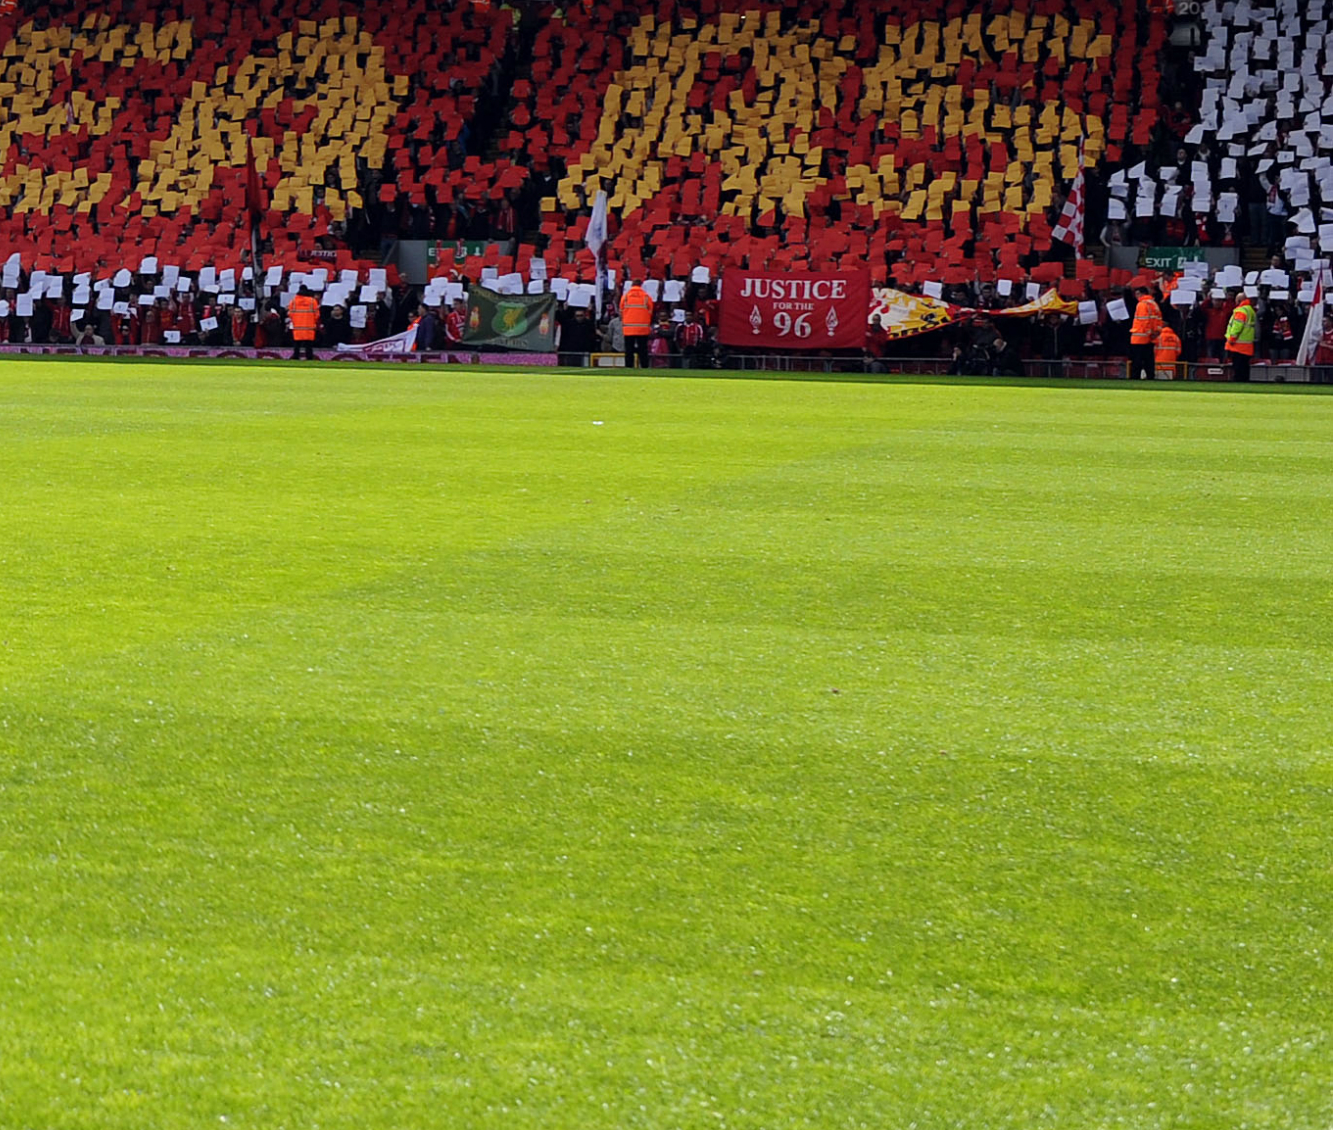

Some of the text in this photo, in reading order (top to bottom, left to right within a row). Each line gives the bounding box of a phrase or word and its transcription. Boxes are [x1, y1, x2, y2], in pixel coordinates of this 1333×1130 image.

[1177, 1, 1200, 15] 20
[1145, 257, 1172, 267] EXIT
[740, 278, 847, 300] JUSTICE
[773, 302, 815, 311] FOR THE
[773, 311, 813, 338] 96
